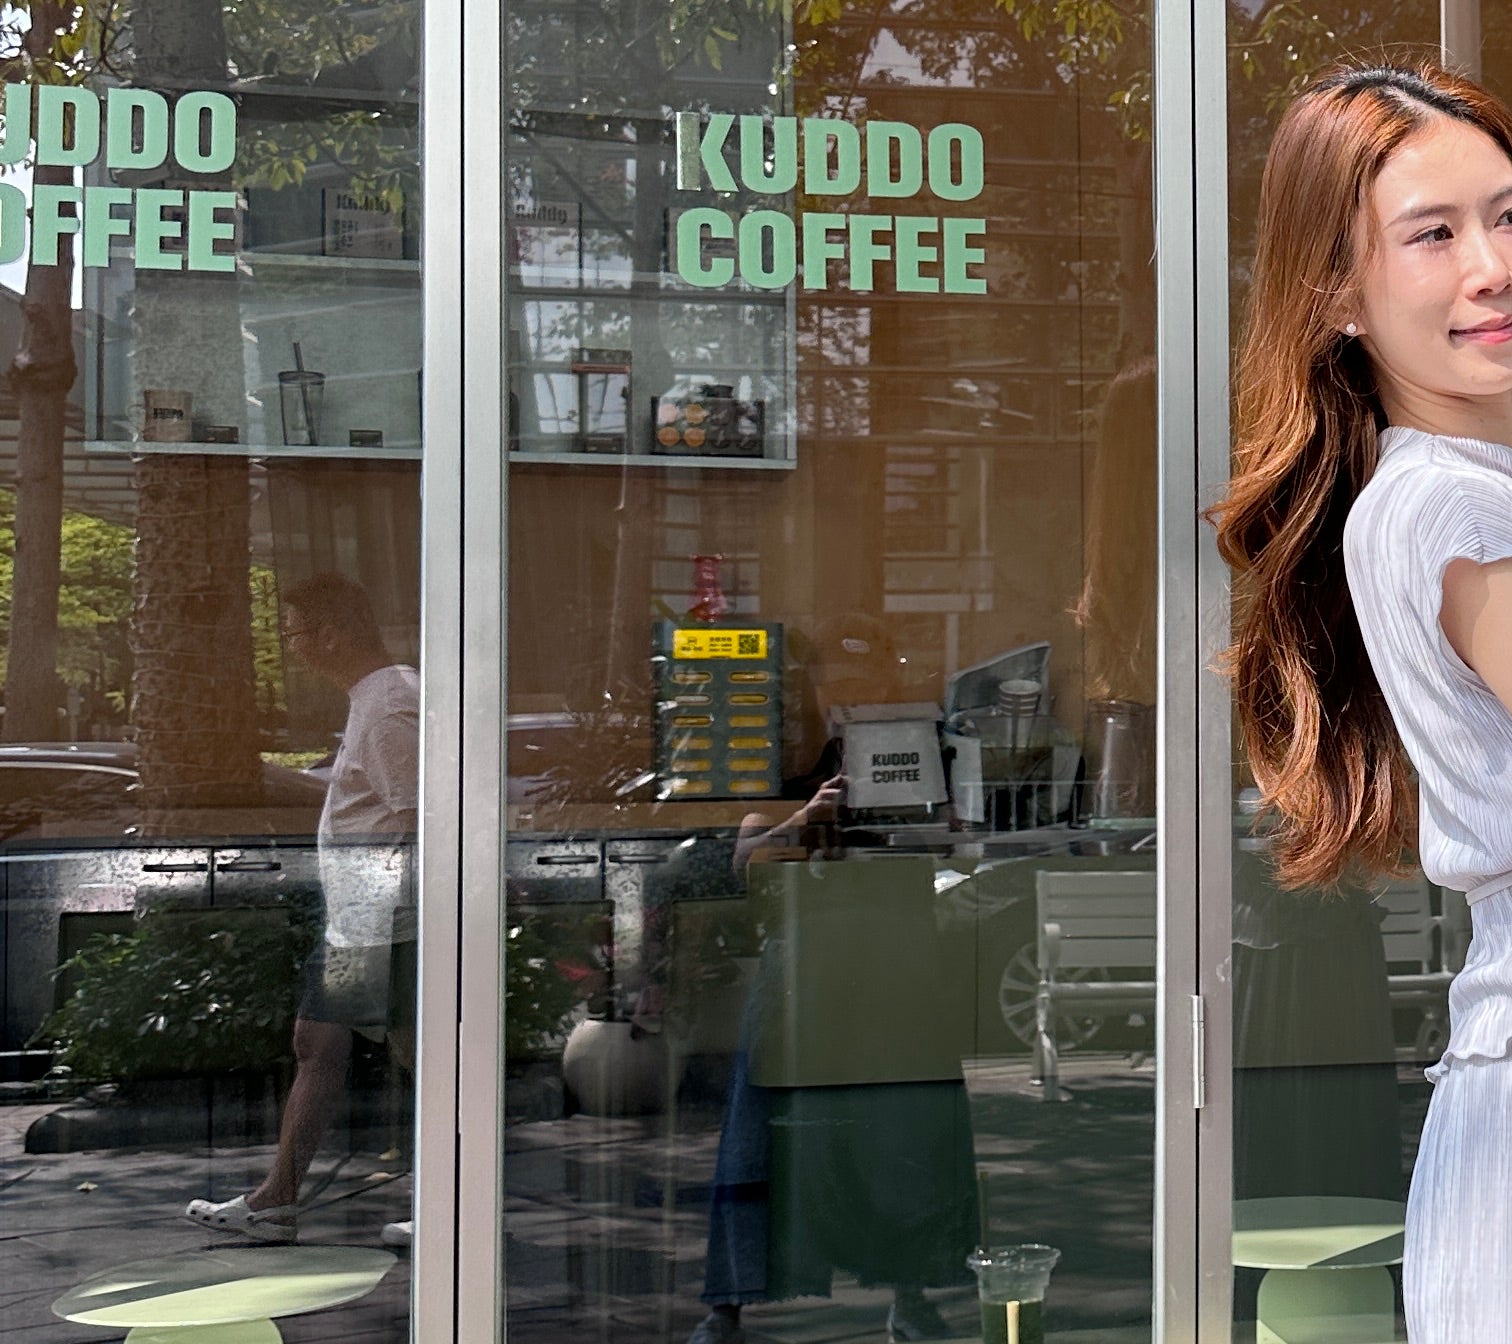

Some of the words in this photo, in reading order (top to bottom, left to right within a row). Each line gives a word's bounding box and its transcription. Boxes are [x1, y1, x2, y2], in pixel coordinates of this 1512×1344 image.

[676, 112, 985, 202] KUDDO
[676, 207, 988, 294] COFFEE
[871, 752, 920, 767] KUDDO
[871, 768, 921, 783] COFFEE
